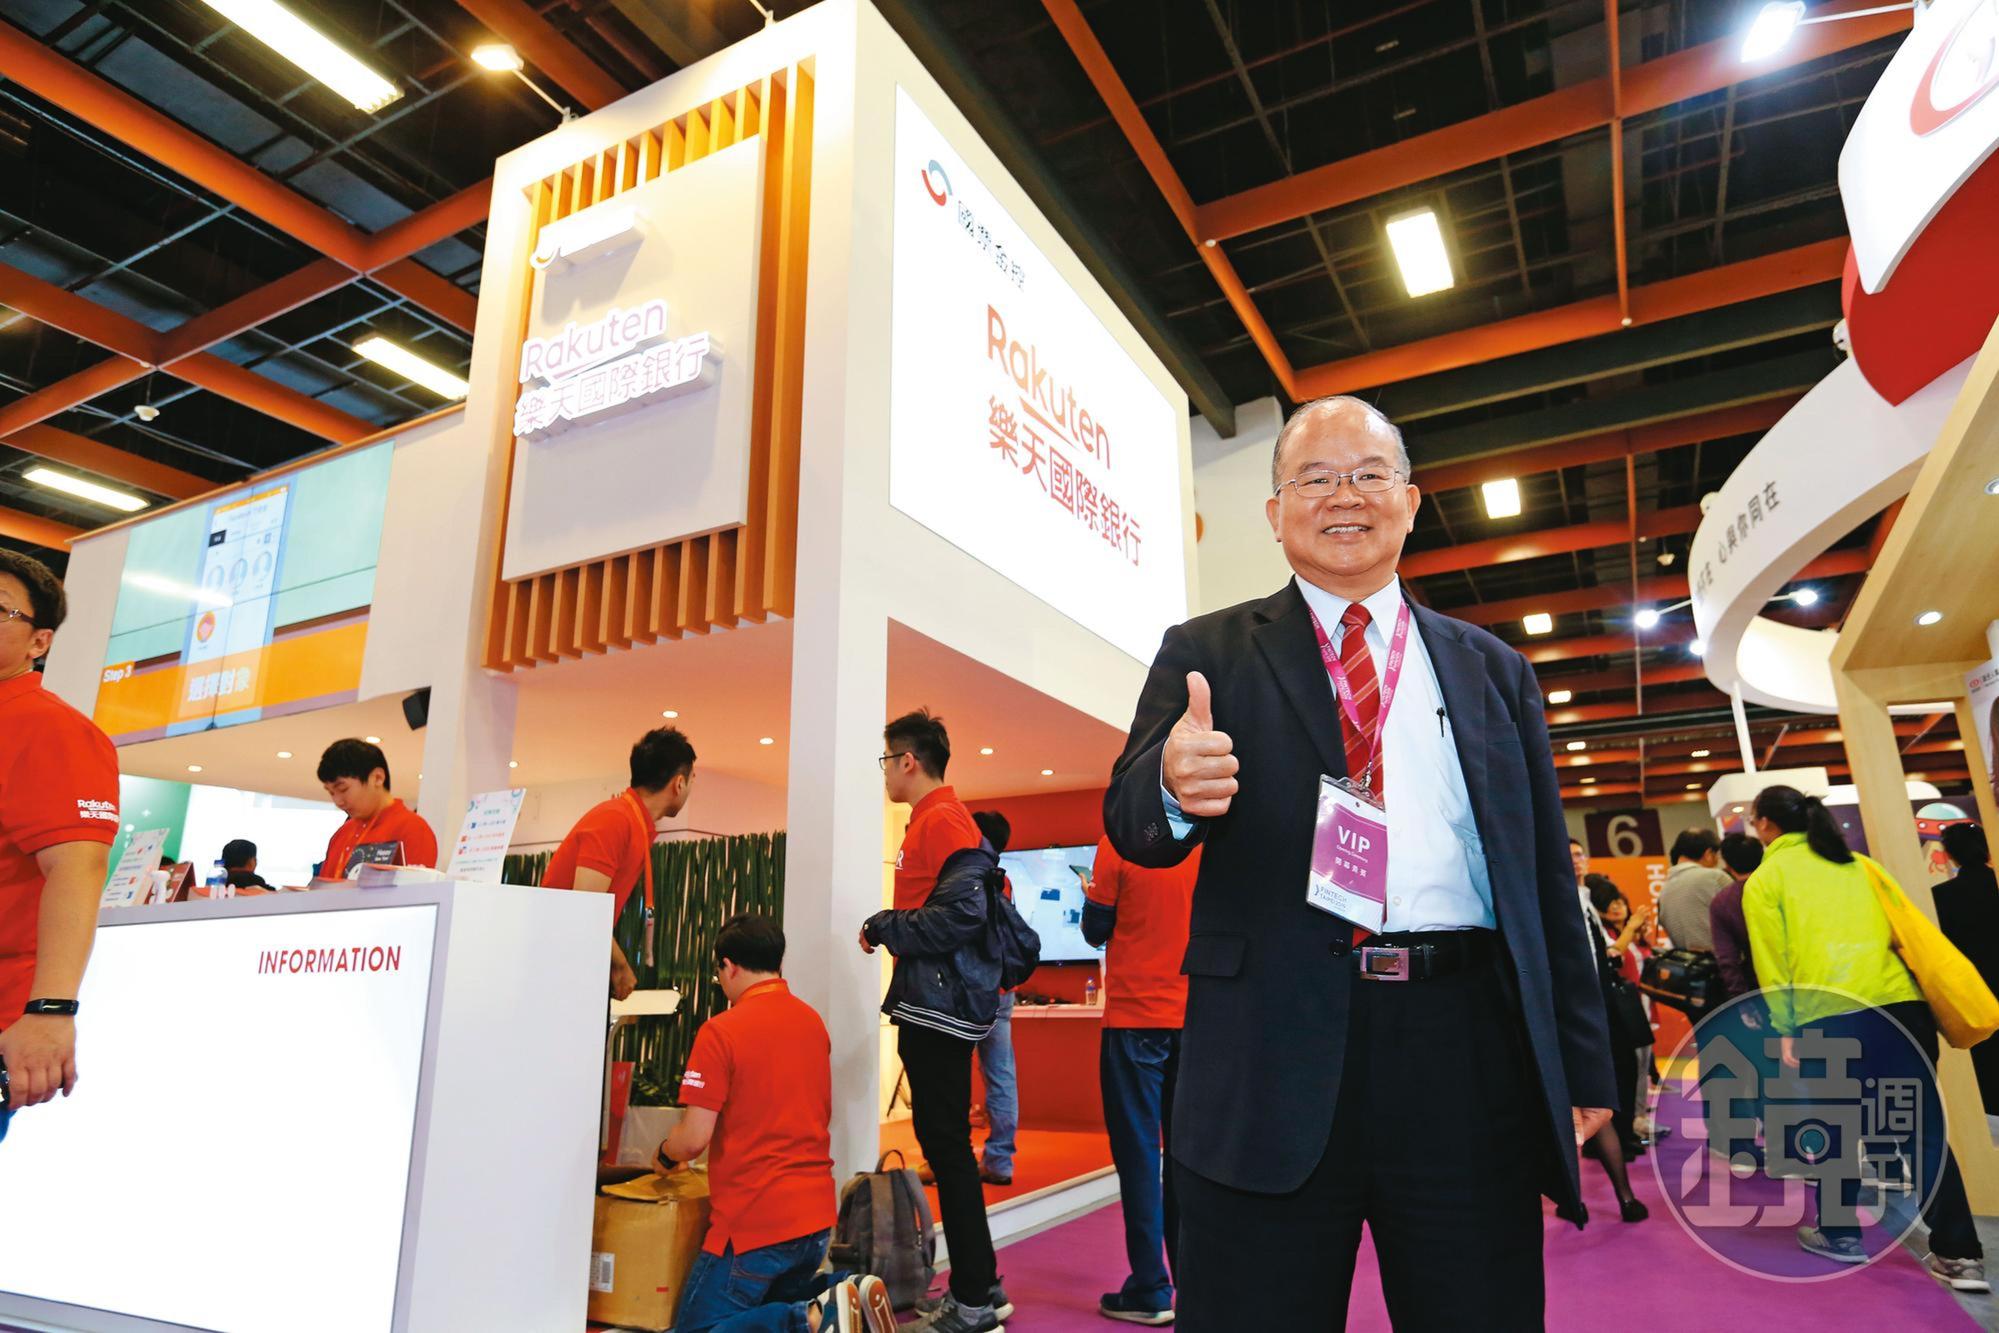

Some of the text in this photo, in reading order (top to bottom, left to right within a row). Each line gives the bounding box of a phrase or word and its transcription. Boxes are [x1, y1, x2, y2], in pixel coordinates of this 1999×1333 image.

[524, 301, 665, 378] Rakuten
[518, 340, 706, 427] 樂天國際銀行
[986, 303, 1112, 470] Rakuten
[987, 395, 1142, 567] 樂天國際銀行
[103, 664, 133, 683] Step 3
[1337, 825, 1371, 853] VIP
[1606, 814, 1643, 858] 6
[258, 944, 402, 974] INFORMATION
